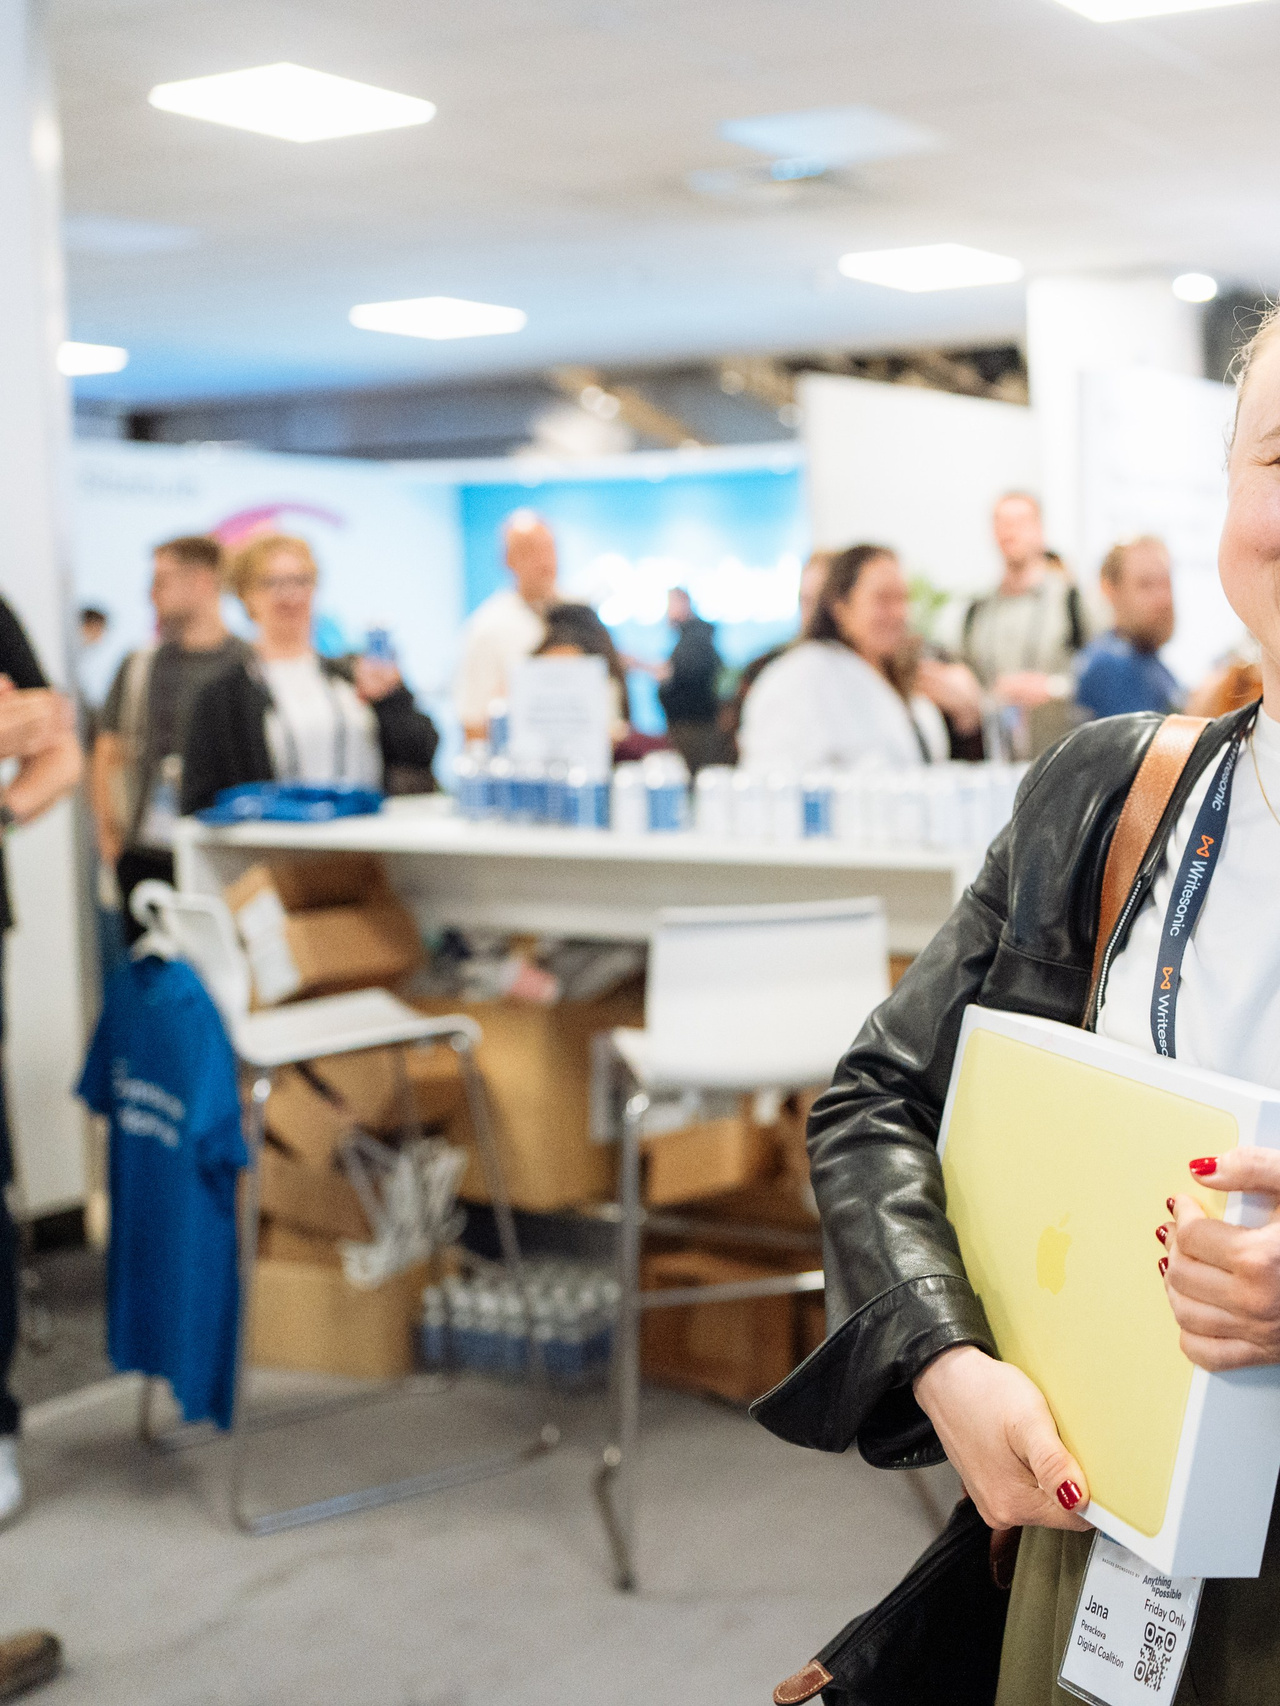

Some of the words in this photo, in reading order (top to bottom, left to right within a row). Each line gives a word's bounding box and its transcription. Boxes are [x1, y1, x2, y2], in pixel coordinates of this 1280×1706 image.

[1169, 860, 1208, 937] Writesonic
[1157, 994, 1170, 1058] Writeso
[1142, 1574, 1172, 1590] Anything
[1154, 1587, 1182, 1600] Possible
[1084, 1594, 1109, 1620] Jana
[1144, 1598, 1168, 1622] Friday
[1168, 1609, 1187, 1632] Only
[1080, 1619, 1107, 1641] Perackova
[1077, 1635, 1098, 1653] Digital
[1097, 1645, 1125, 1669] Coalition
